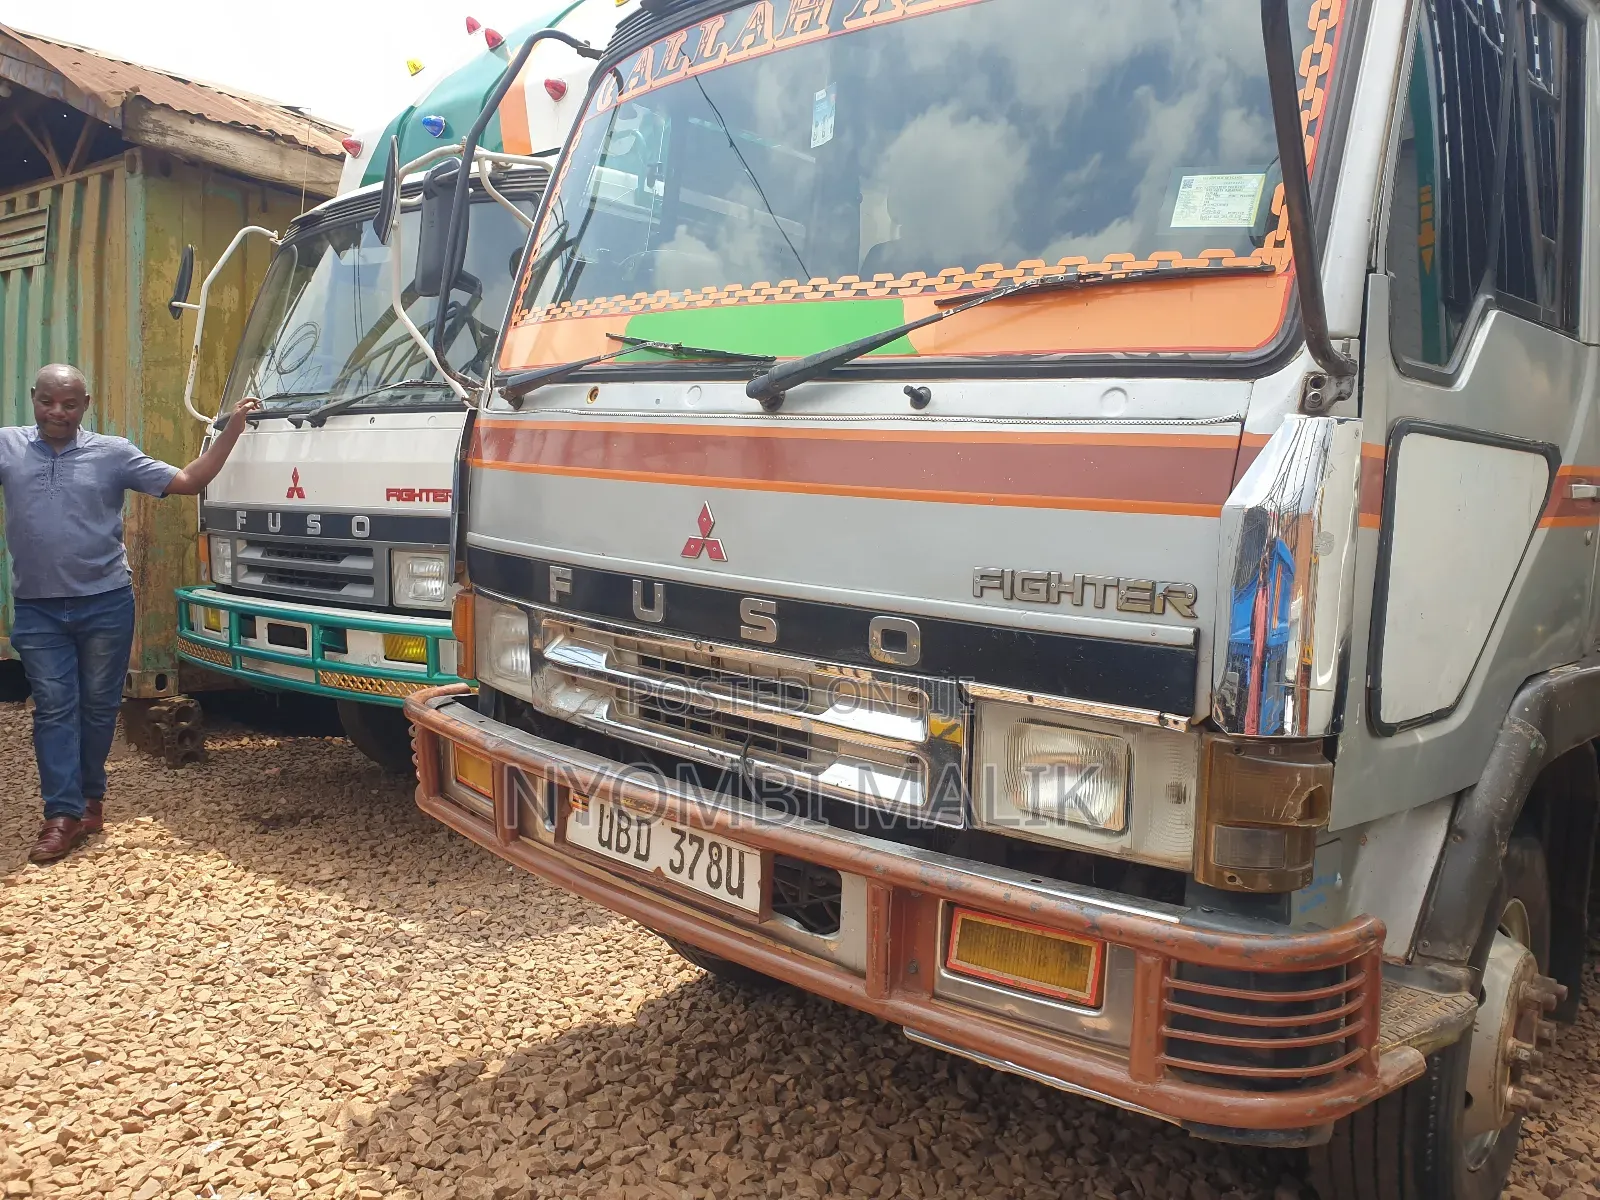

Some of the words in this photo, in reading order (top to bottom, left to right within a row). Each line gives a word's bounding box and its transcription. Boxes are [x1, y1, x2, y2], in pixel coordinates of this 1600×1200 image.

[236, 511, 371, 538] FUSO
[549, 565, 921, 667] FUSO
[972, 566, 1198, 618] FIGHTER
[597, 803, 652, 862] UBD
[669, 826, 745, 900] 378U
